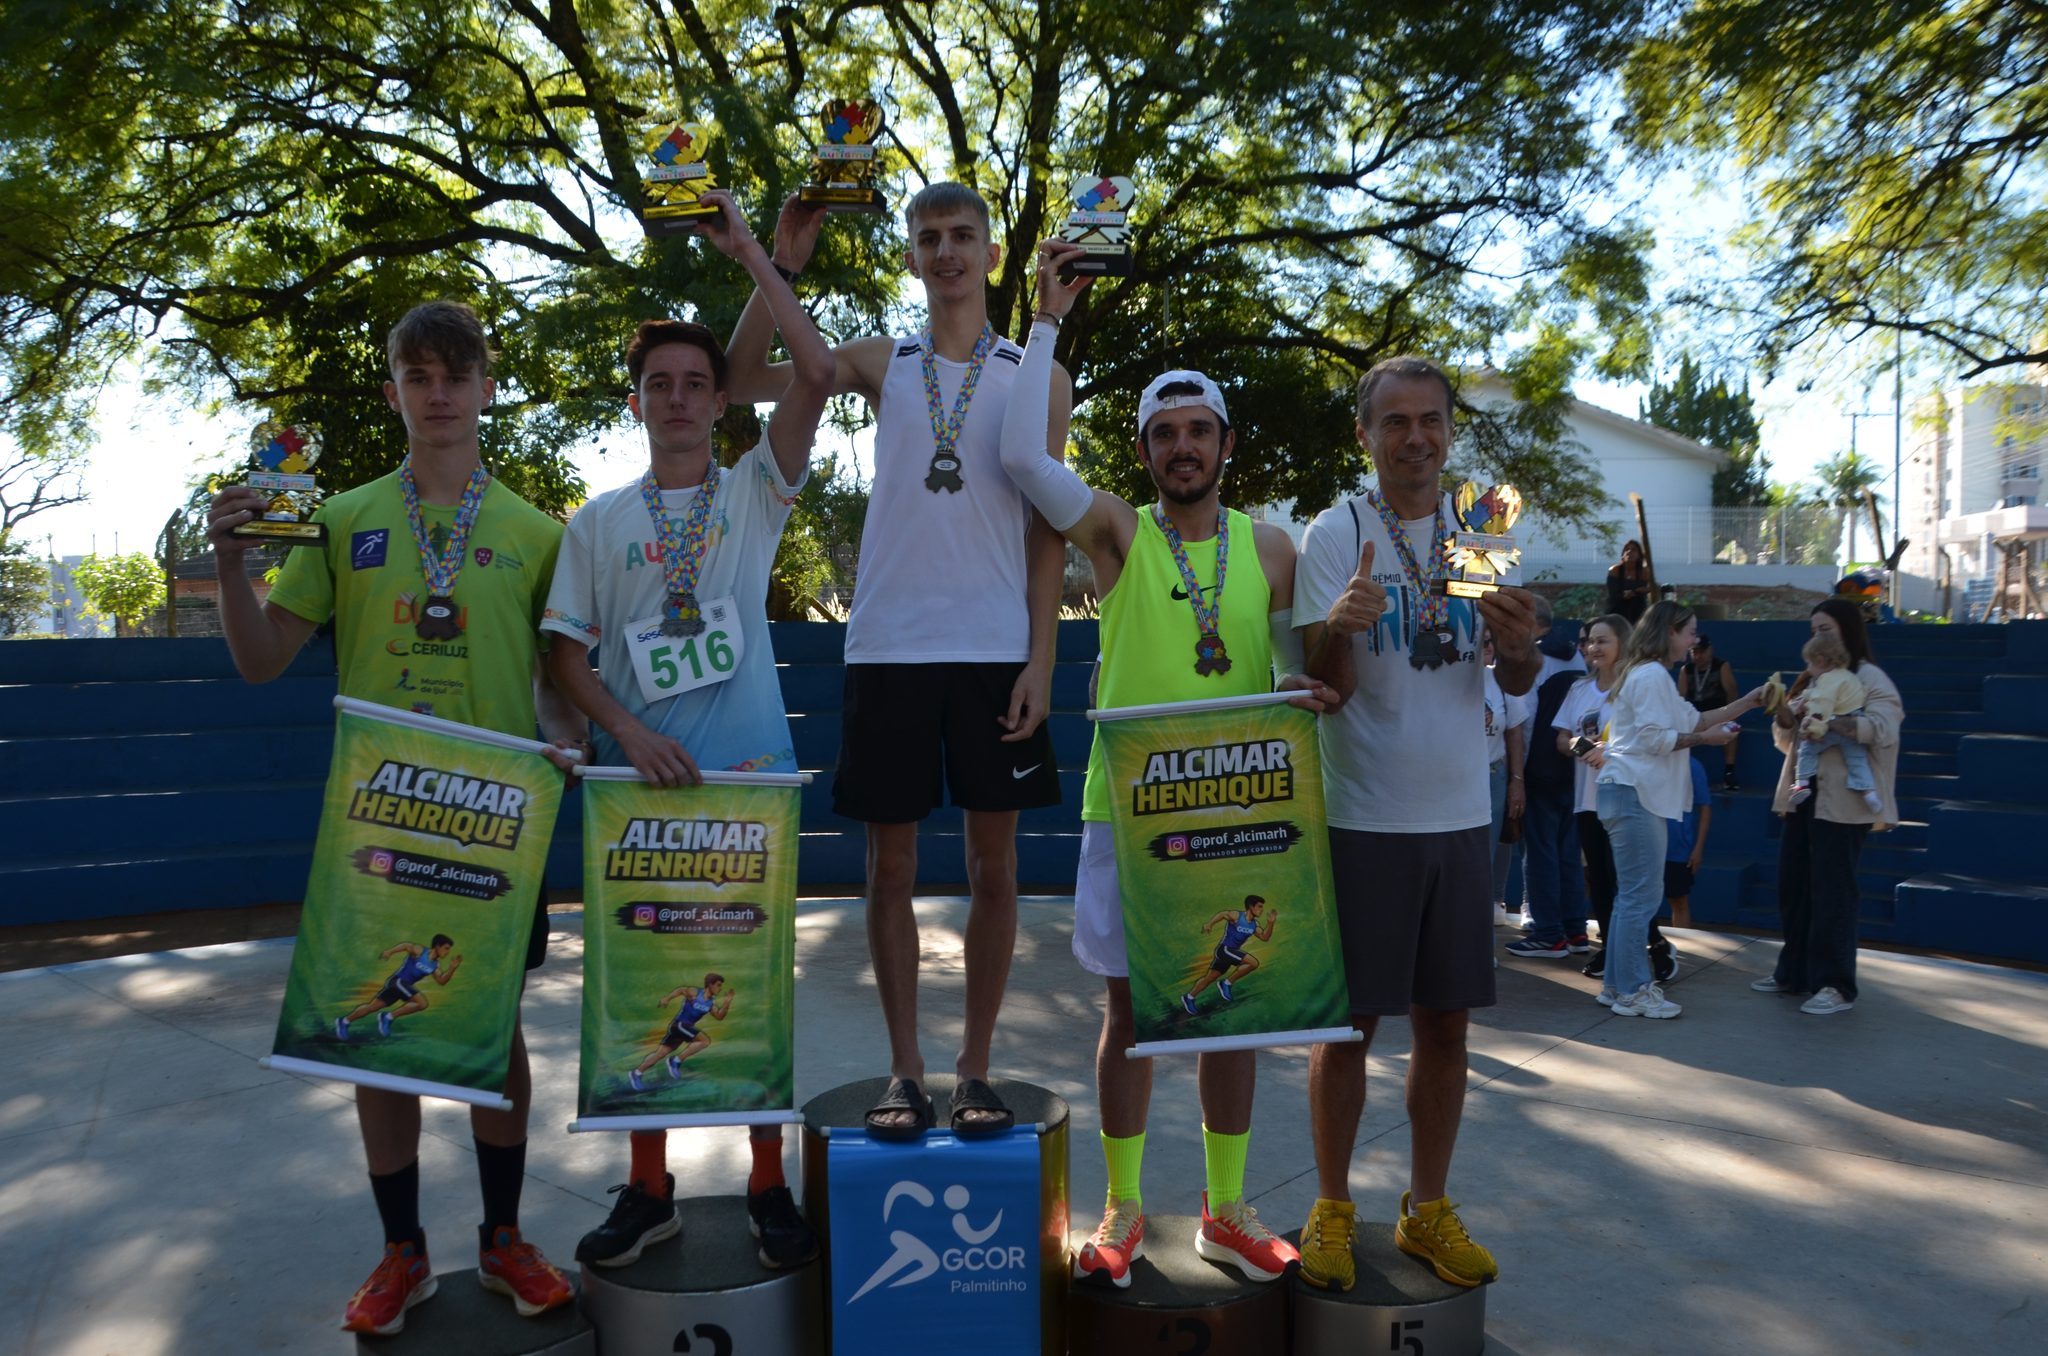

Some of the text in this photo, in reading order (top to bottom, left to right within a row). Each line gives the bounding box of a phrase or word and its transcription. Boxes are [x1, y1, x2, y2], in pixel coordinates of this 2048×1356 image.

[1372, 573, 1401, 584] RÊMIO
[412, 643, 469, 658] CERILUZ
[650, 631, 734, 689] 516
[1145, 741, 1287, 783] ALCIMAR
[370, 762, 525, 817] ALCIMAR
[1137, 771, 1289, 812] HENRIQUE
[353, 791, 518, 846] HENRIQUE
[622, 820, 765, 851] ALCIMAR
[1190, 828, 1287, 849] @prof_alcimarh
[395, 858, 498, 888] @prof_alcimarh
[609, 851, 763, 883] HENRIQUE
[658, 908, 754, 922] @prof_alcimarh
[942, 1247, 1026, 1271] GCOR
[951, 1279, 1027, 1293] Palmitinho
